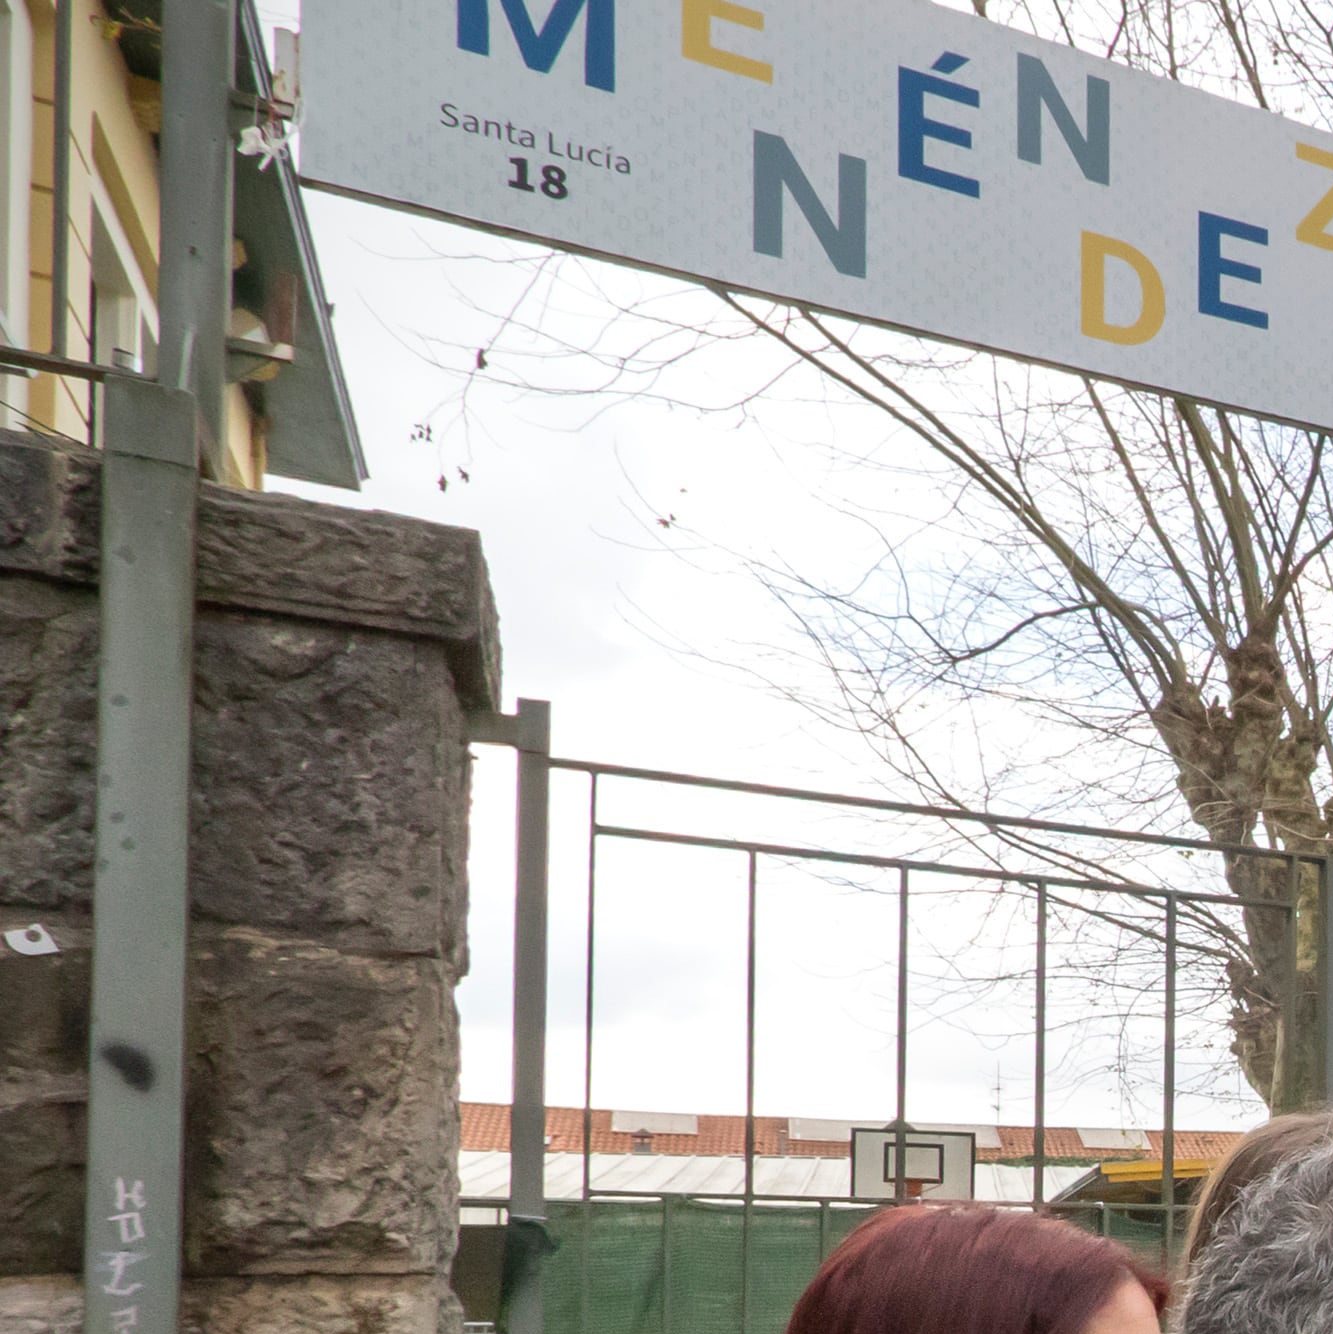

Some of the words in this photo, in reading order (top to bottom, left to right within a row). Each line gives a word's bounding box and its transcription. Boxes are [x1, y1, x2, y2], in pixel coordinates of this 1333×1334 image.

[440, 102, 535, 149] Santa
[548, 131, 631, 175] Lucía
[508, 156, 569, 200] 18
